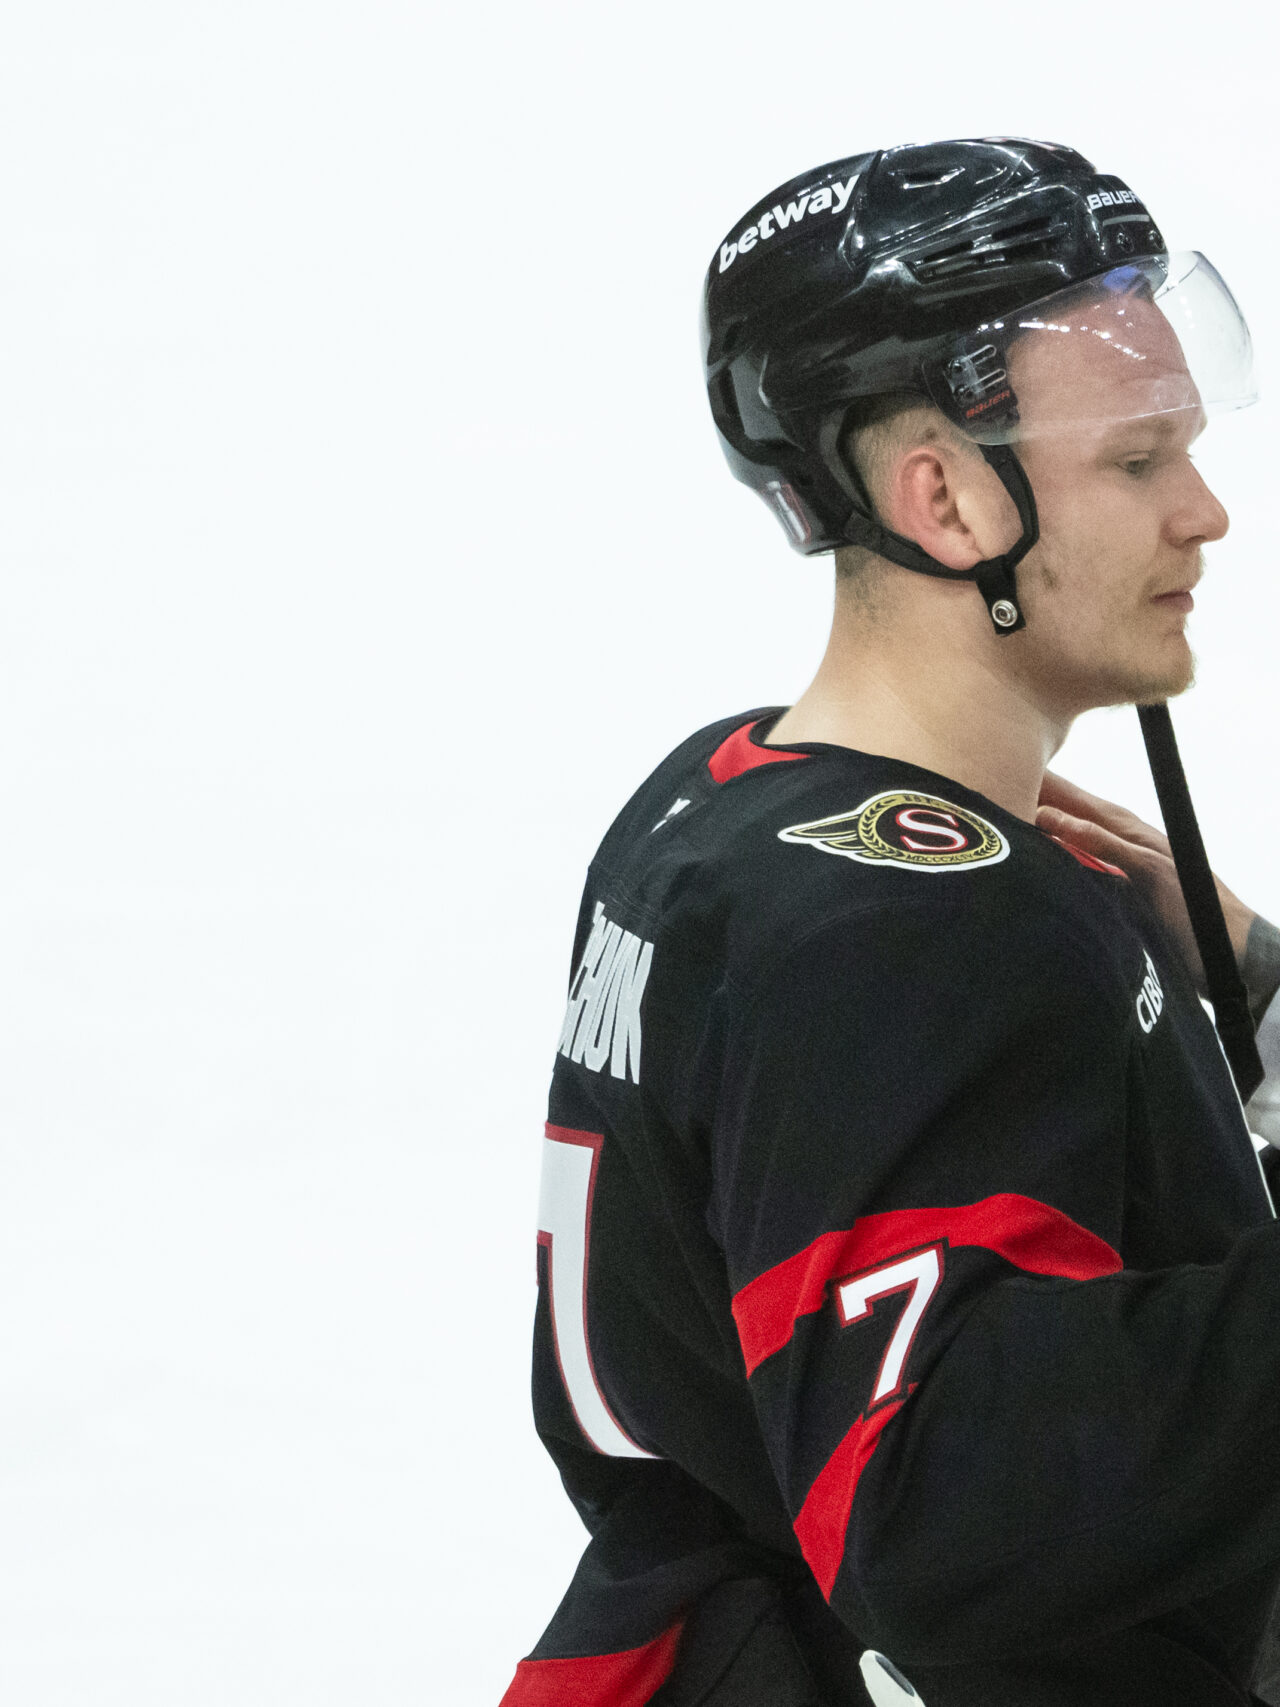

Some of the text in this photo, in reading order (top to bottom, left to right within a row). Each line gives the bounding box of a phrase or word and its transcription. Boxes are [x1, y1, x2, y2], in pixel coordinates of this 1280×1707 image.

[719, 174, 860, 274] betway
[896, 809, 968, 852] S
[836, 1242, 946, 1411] 7
